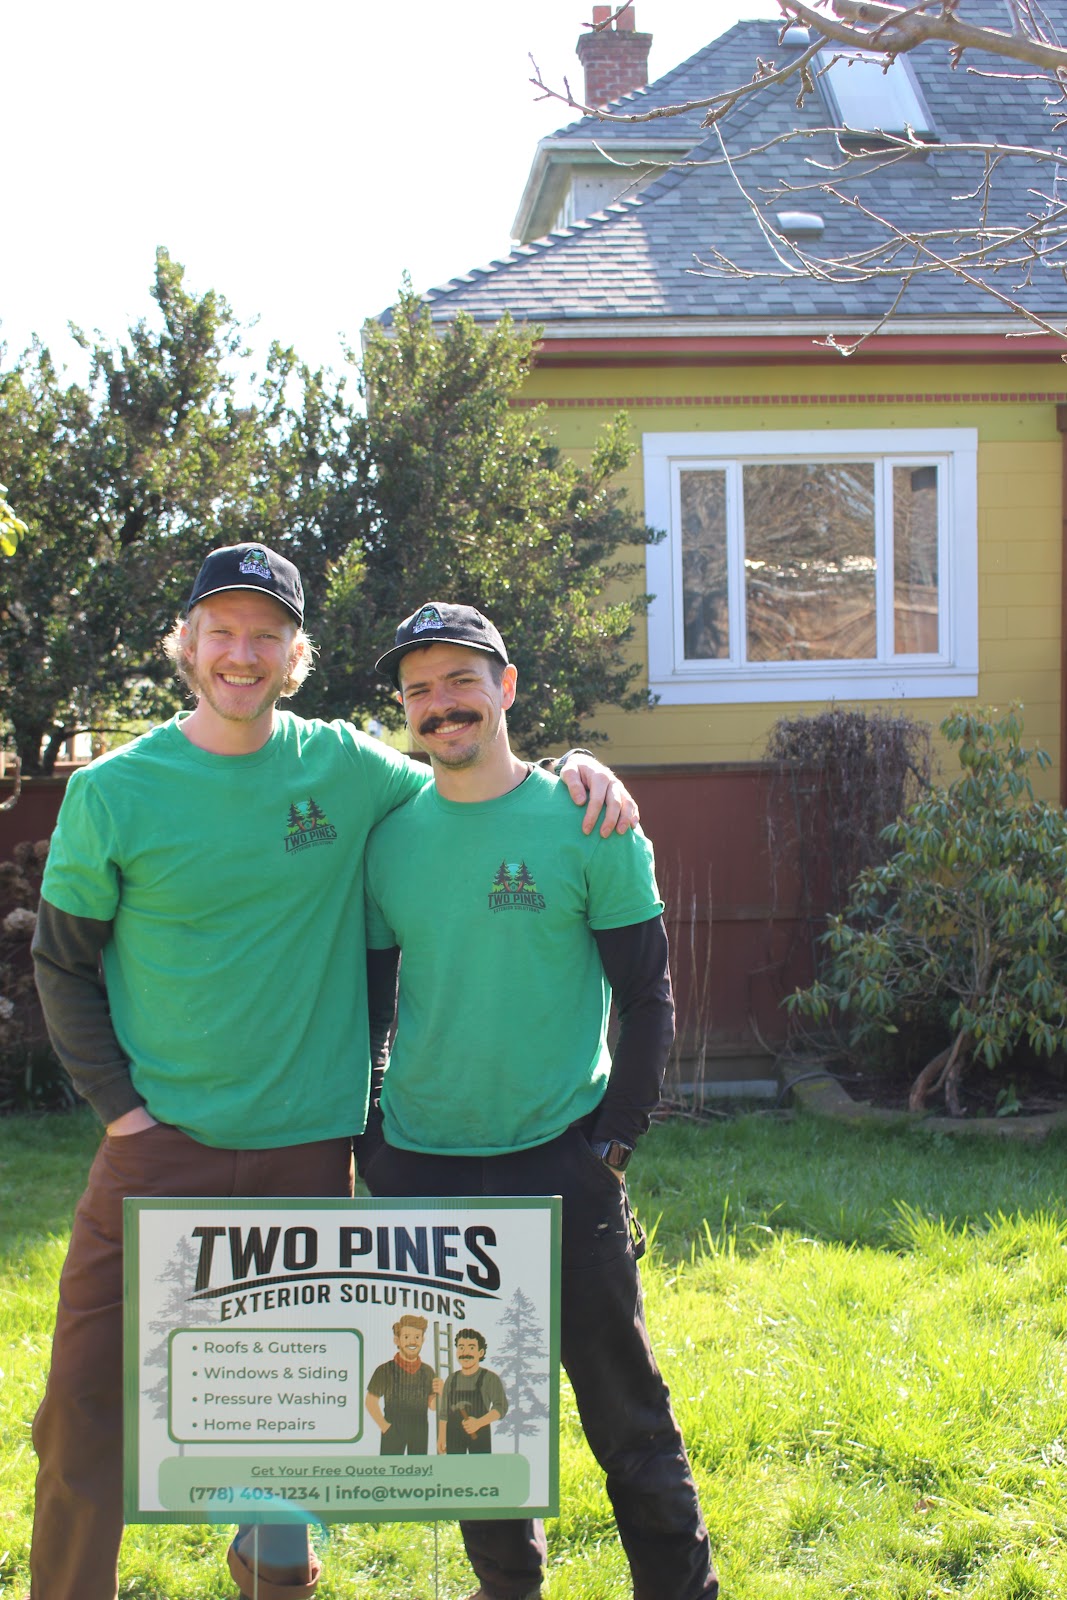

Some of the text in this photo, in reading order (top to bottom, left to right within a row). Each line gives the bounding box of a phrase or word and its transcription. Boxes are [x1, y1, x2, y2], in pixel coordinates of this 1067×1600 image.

[284, 825, 337, 852] TWO PINES
[488, 894, 546, 909] TWO PINES
[190, 1225, 502, 1298] TWO PINES
[220, 1283, 467, 1322] EXTERIOR SOLUTIONS
[203, 1341, 327, 1354] Roofs & Gutters
[203, 1366, 348, 1382] Windows & Siding
[203, 1391, 347, 1408] Pressure Washing
[203, 1417, 316, 1433] Home Repairs
[251, 1464, 434, 1477] Get Your Free Quote Today!
[189, 1486, 234, 1503] (778)
[239, 1486, 321, 1501] 403-1234
[335, 1483, 500, 1502] info@twopines.ca
